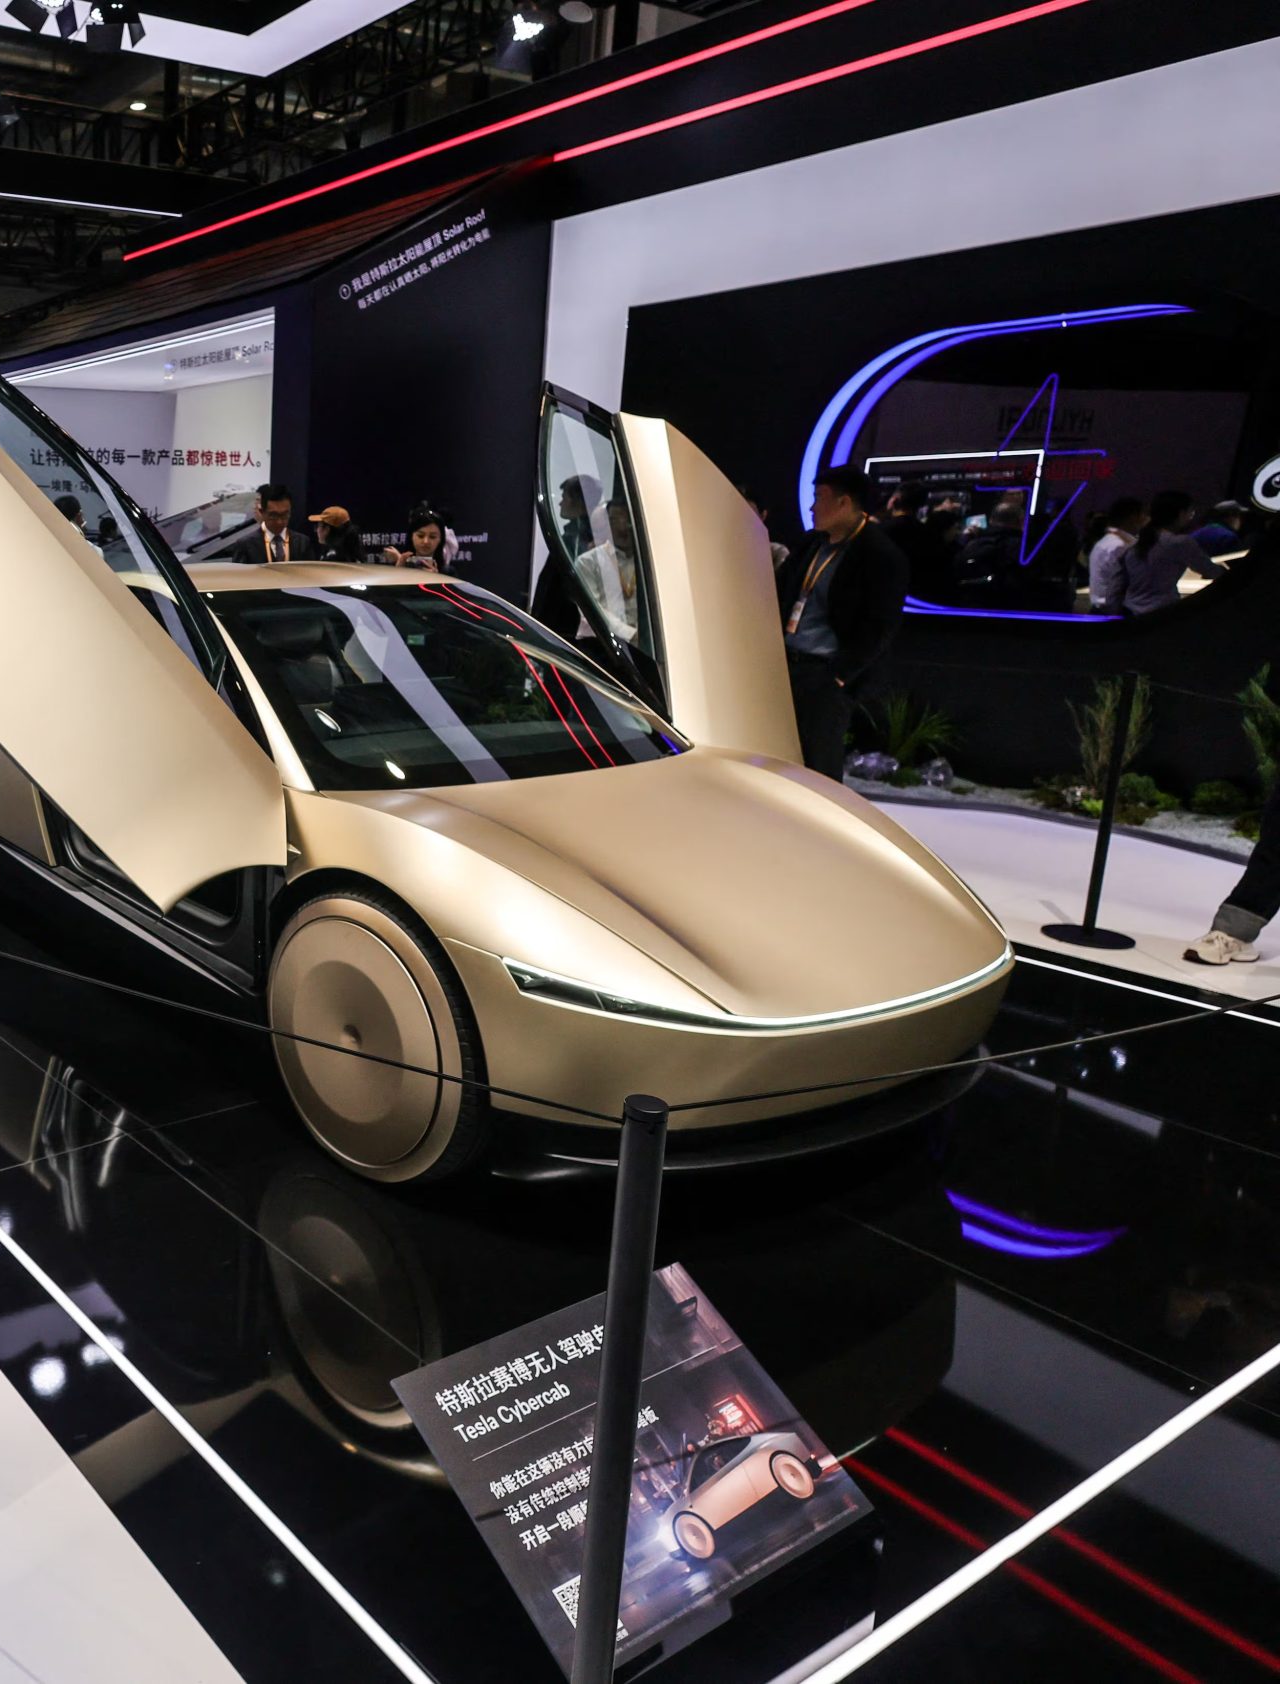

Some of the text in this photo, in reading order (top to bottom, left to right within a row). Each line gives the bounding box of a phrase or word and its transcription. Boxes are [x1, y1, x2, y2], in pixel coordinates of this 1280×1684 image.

[442, 222, 465, 241] Solar
[465, 208, 486, 229] Roof
[241, 343, 262, 358] Solar
[29, 448, 262, 468] 让特的每一款产品都惊艳世人。
[453, 1381, 571, 1443] Tesla Cybercab
[518, 1499, 589, 1551] 开启一段顺
